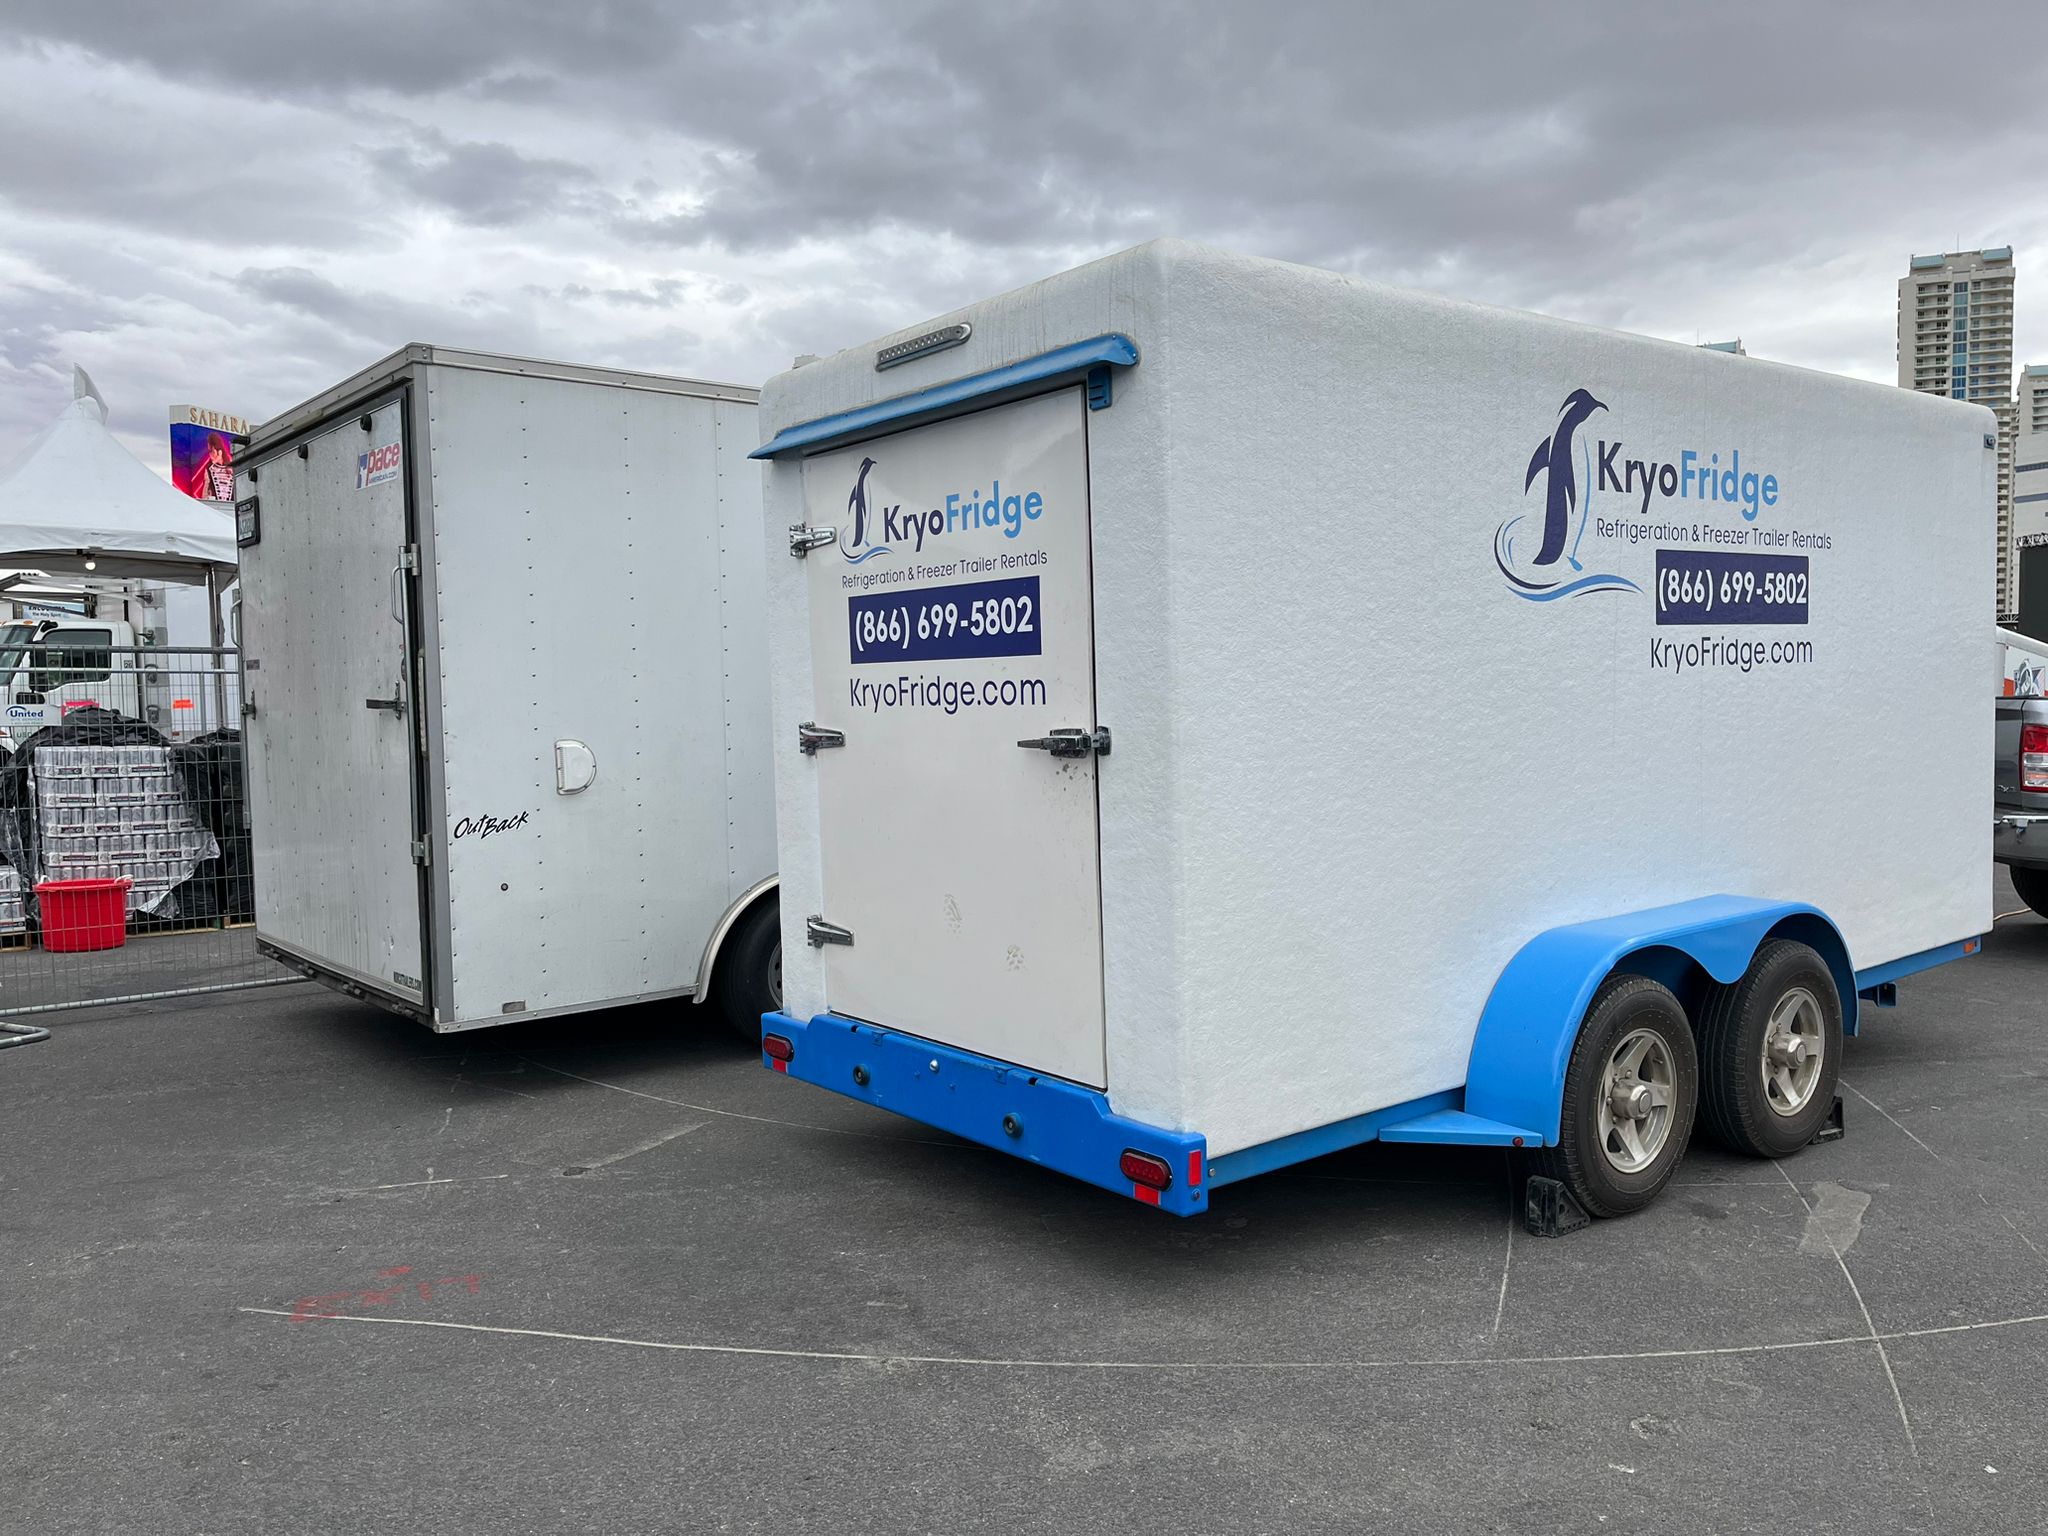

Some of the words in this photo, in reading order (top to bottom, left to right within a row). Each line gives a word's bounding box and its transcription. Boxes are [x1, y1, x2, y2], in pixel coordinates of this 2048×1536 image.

[189, 407, 248, 434] SAHARA
[365, 443, 400, 486] pace
[1598, 440, 1778, 521] KryoFridge
[883, 480, 1043, 552] KryoFridge
[1596, 518, 1688, 544] Refrigeration
[1691, 526, 1700, 542] &
[1703, 525, 1749, 545] Freezer
[1752, 528, 1789, 547] Trailer
[1792, 531, 1832, 549] Rentals
[842, 569, 906, 590] Refrigeration
[908, 567, 915, 581] &
[916, 561, 957, 580] Freezer
[959, 554, 998, 574] Trailer
[1000, 550, 1048, 570] Rentals
[1658, 568, 1713, 612] (866)
[1720, 571, 1807, 604] 699-5802
[855, 607, 910, 652] (866)
[917, 595, 1033, 640] 699-5802
[1650, 636, 1813, 674] KryoFridge.com
[10, 710, 44, 718] United
[849, 675, 1046, 715] KryoFridge.com
[454, 811, 529, 840] OutBack
